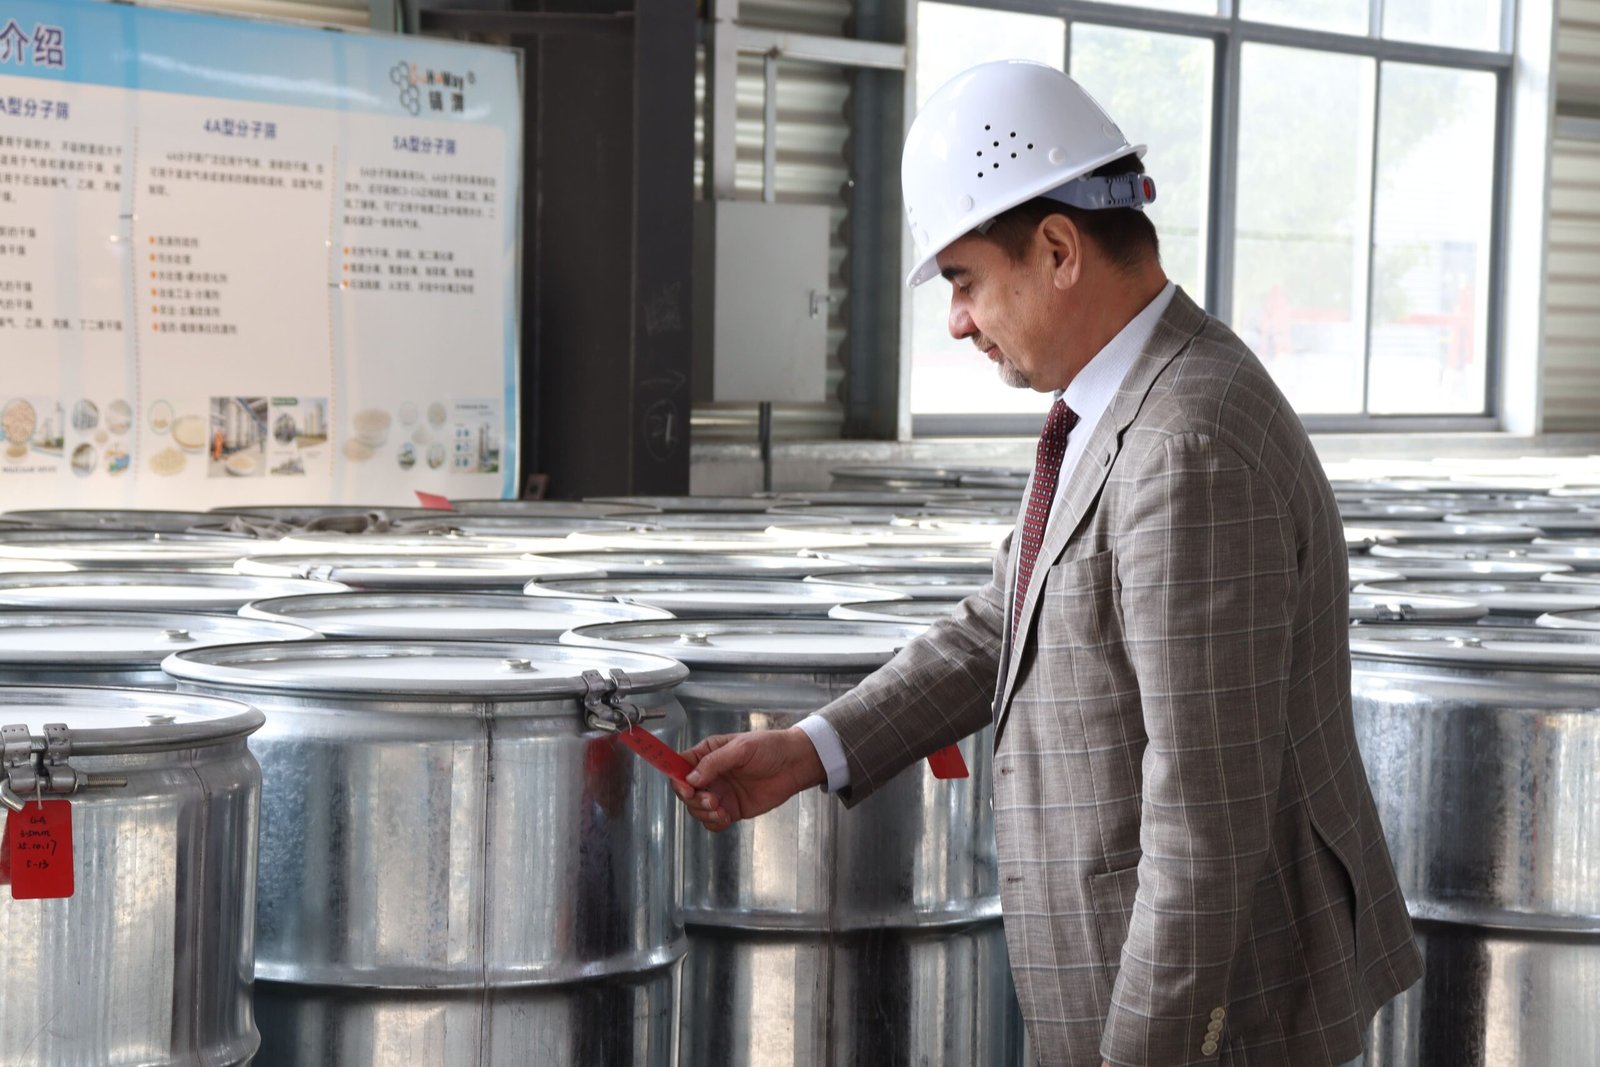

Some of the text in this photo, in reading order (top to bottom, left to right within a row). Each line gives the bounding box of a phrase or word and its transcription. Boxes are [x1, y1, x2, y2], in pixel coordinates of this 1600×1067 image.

[0, 20, 64, 67] 介绍
[204, 118, 277, 139] 4A型分子筛
[393, 136, 457, 155] 5A型分子筛
